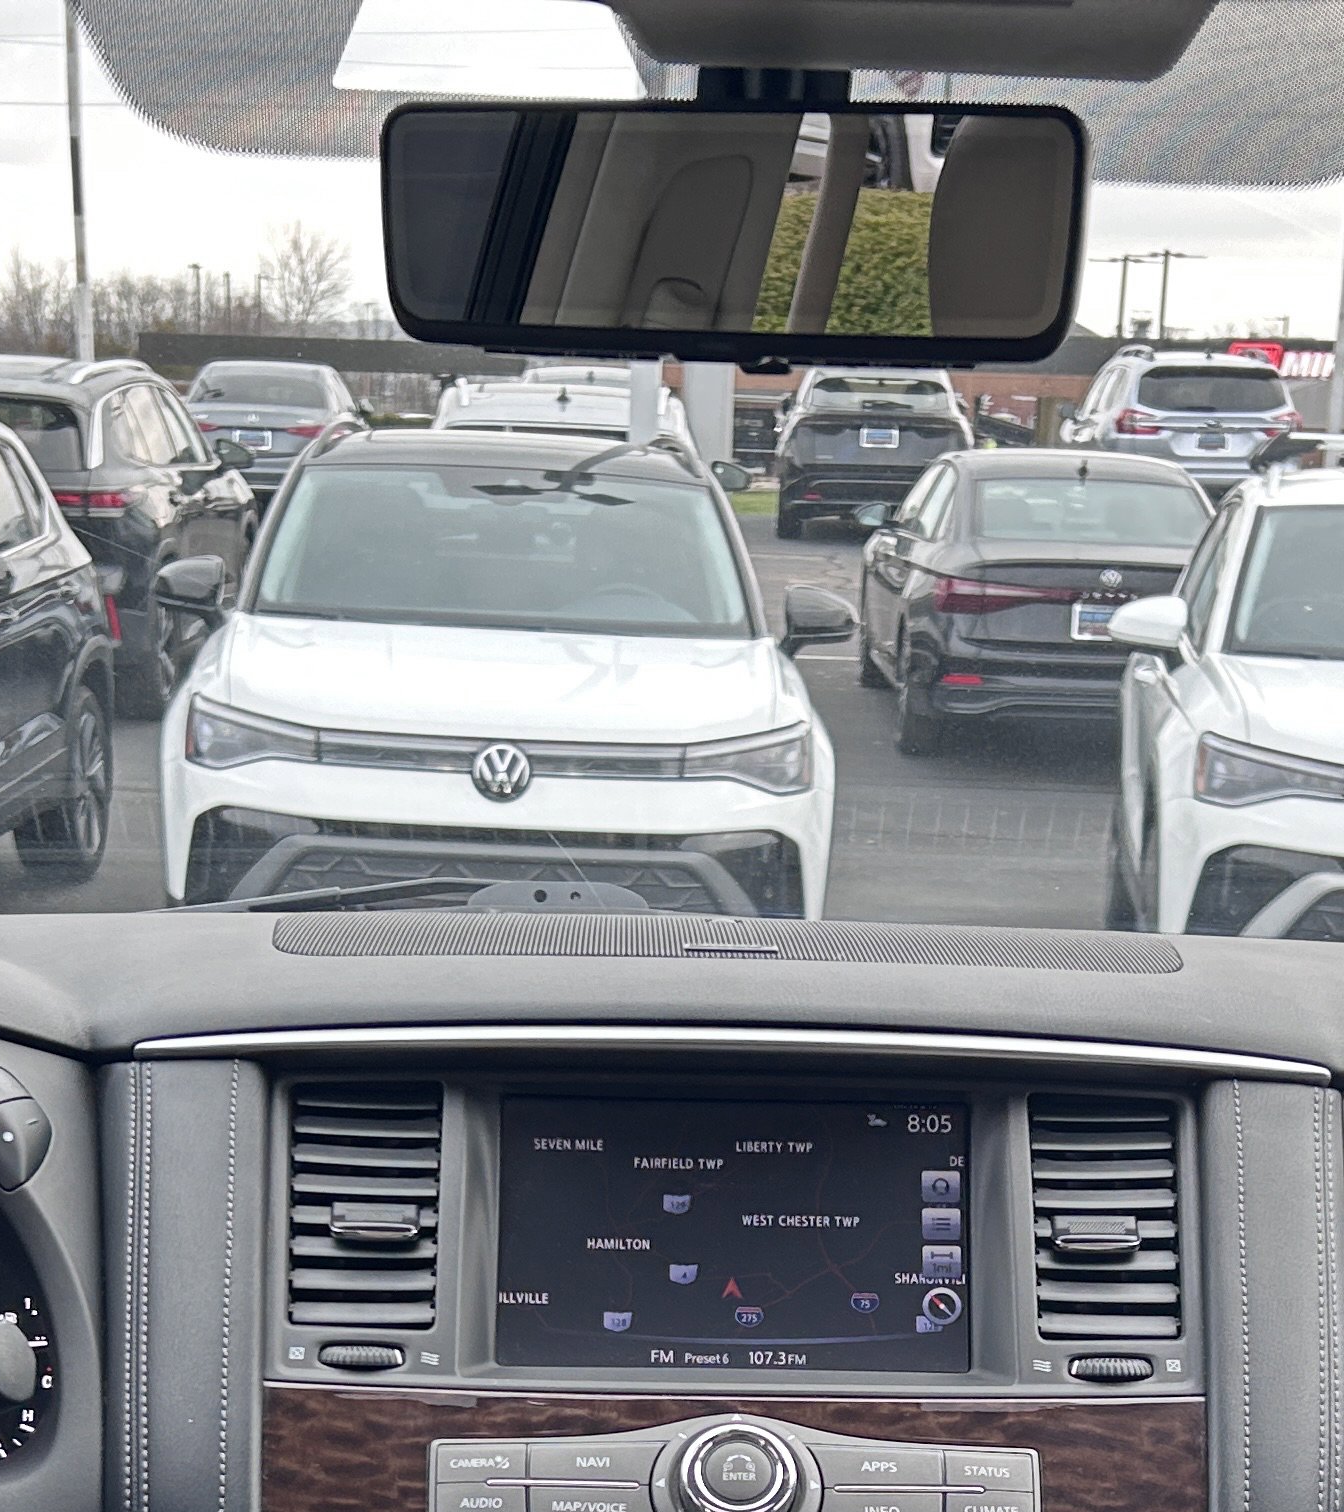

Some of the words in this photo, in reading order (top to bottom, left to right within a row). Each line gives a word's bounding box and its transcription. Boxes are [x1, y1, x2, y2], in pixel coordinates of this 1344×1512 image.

[907, 1114, 952, 1133] 8:05
[533, 1138, 572, 1150] SEVEN
[575, 1139, 604, 1151] MILE
[735, 1141, 783, 1153] LIBERTY
[787, 1142, 813, 1153] TWP
[633, 1157, 694, 1169] FAIRFIELD
[698, 1158, 724, 1170] TWP
[742, 1214, 774, 1226] WEST
[778, 1215, 831, 1227] CHESTER
[834, 1216, 860, 1228] TWP
[586, 1238, 651, 1250] HAMILTON
[498, 1292, 549, 1304] ILLVILLE
[859, 1299, 871, 1309] 75
[741, 1314, 758, 1323] 275
[650, 1350, 674, 1364] FM
[22, 1409, 34, 1422] H
[449, 1458, 495, 1468] CAMERA
[576, 1456, 610, 1468] NAVI
[860, 1461, 898, 1473] APPS
[722, 1472, 757, 1481] ENTER
[964, 1465, 1010, 1478] STATUS
[459, 1497, 503, 1509] AUDIO
